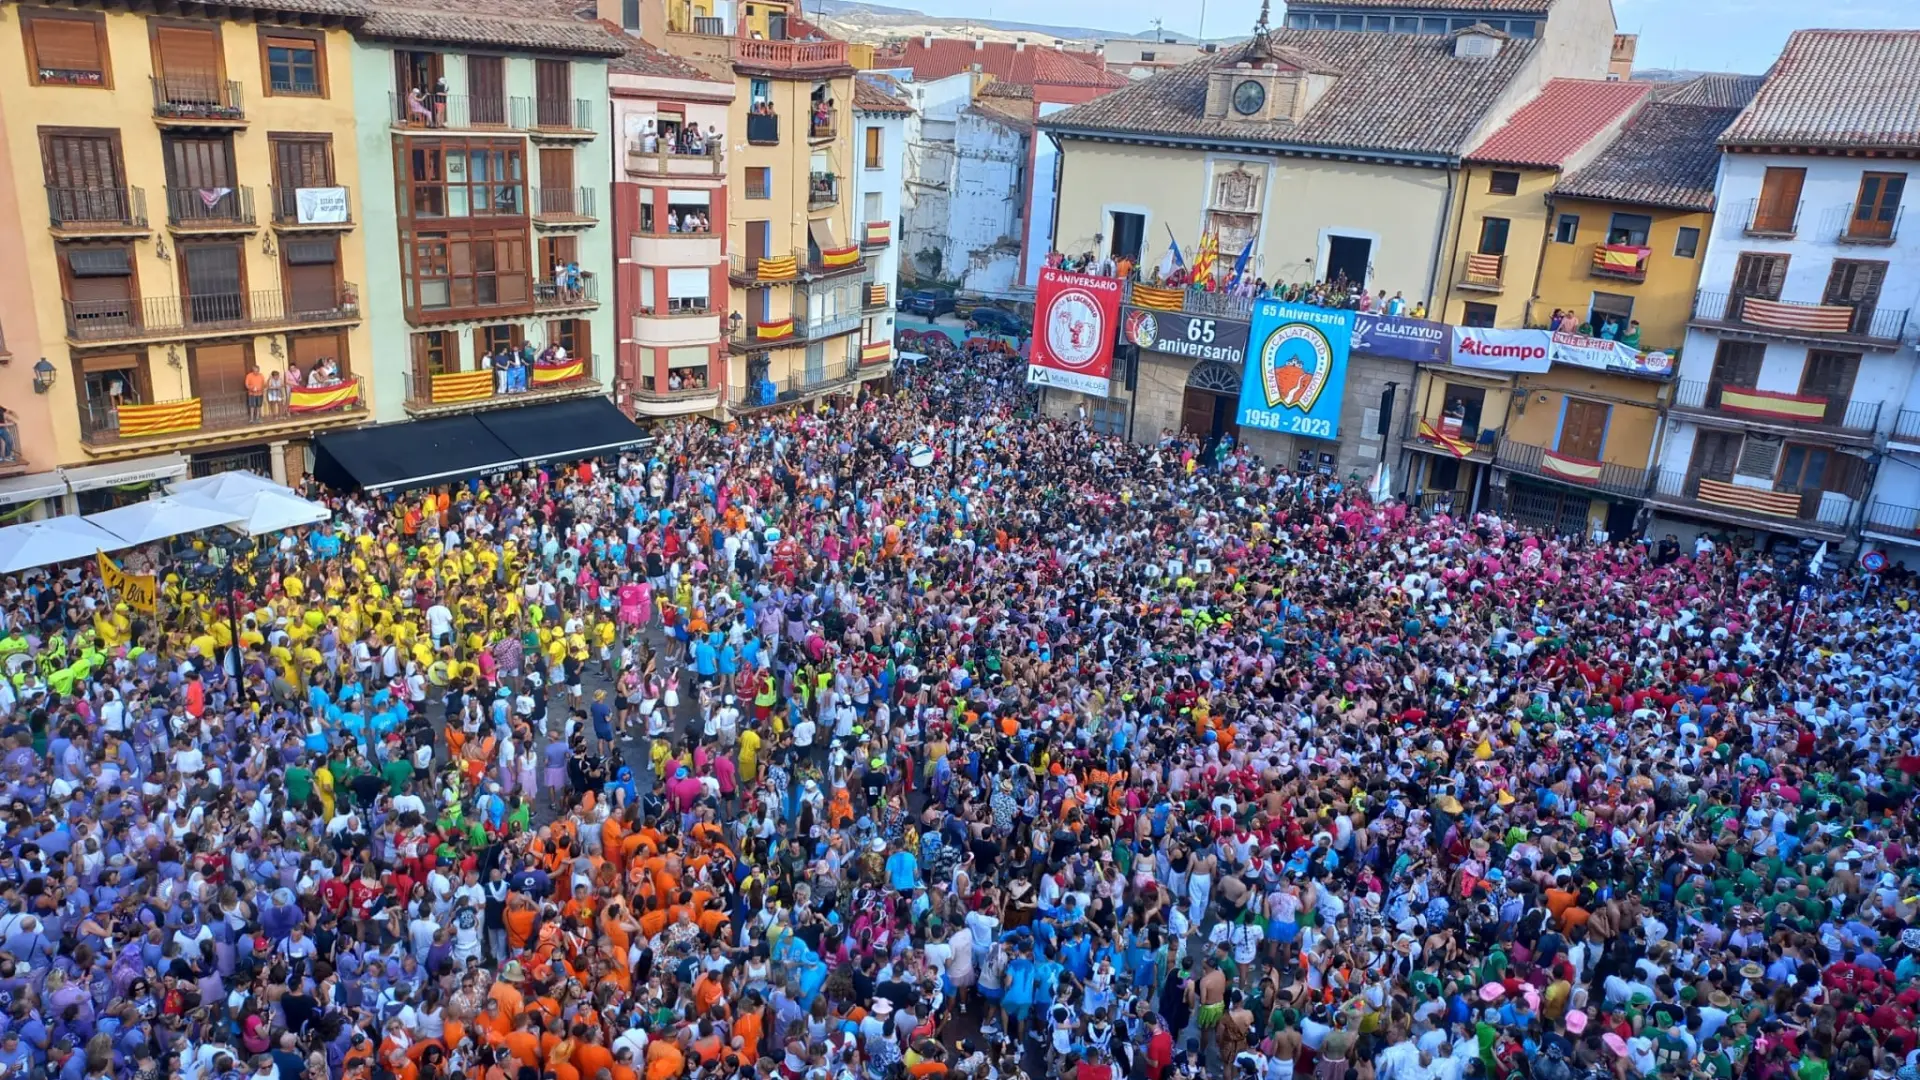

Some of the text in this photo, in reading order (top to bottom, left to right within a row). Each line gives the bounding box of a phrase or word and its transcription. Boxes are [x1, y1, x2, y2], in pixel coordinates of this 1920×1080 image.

[1044, 271, 1118, 291] 45 ANIVERSARIO
[1262, 304, 1345, 326] 65 Aniversario
[1187, 318, 1216, 343] 65
[1271, 328, 1326, 356] CALATAYUD
[1375, 322, 1443, 340] CALATAYUD
[1158, 338, 1241, 362] aniversario
[1458, 337, 1546, 361] Alcampo
[1245, 408, 1280, 428] 1958
[1291, 416, 1331, 436] 2023
